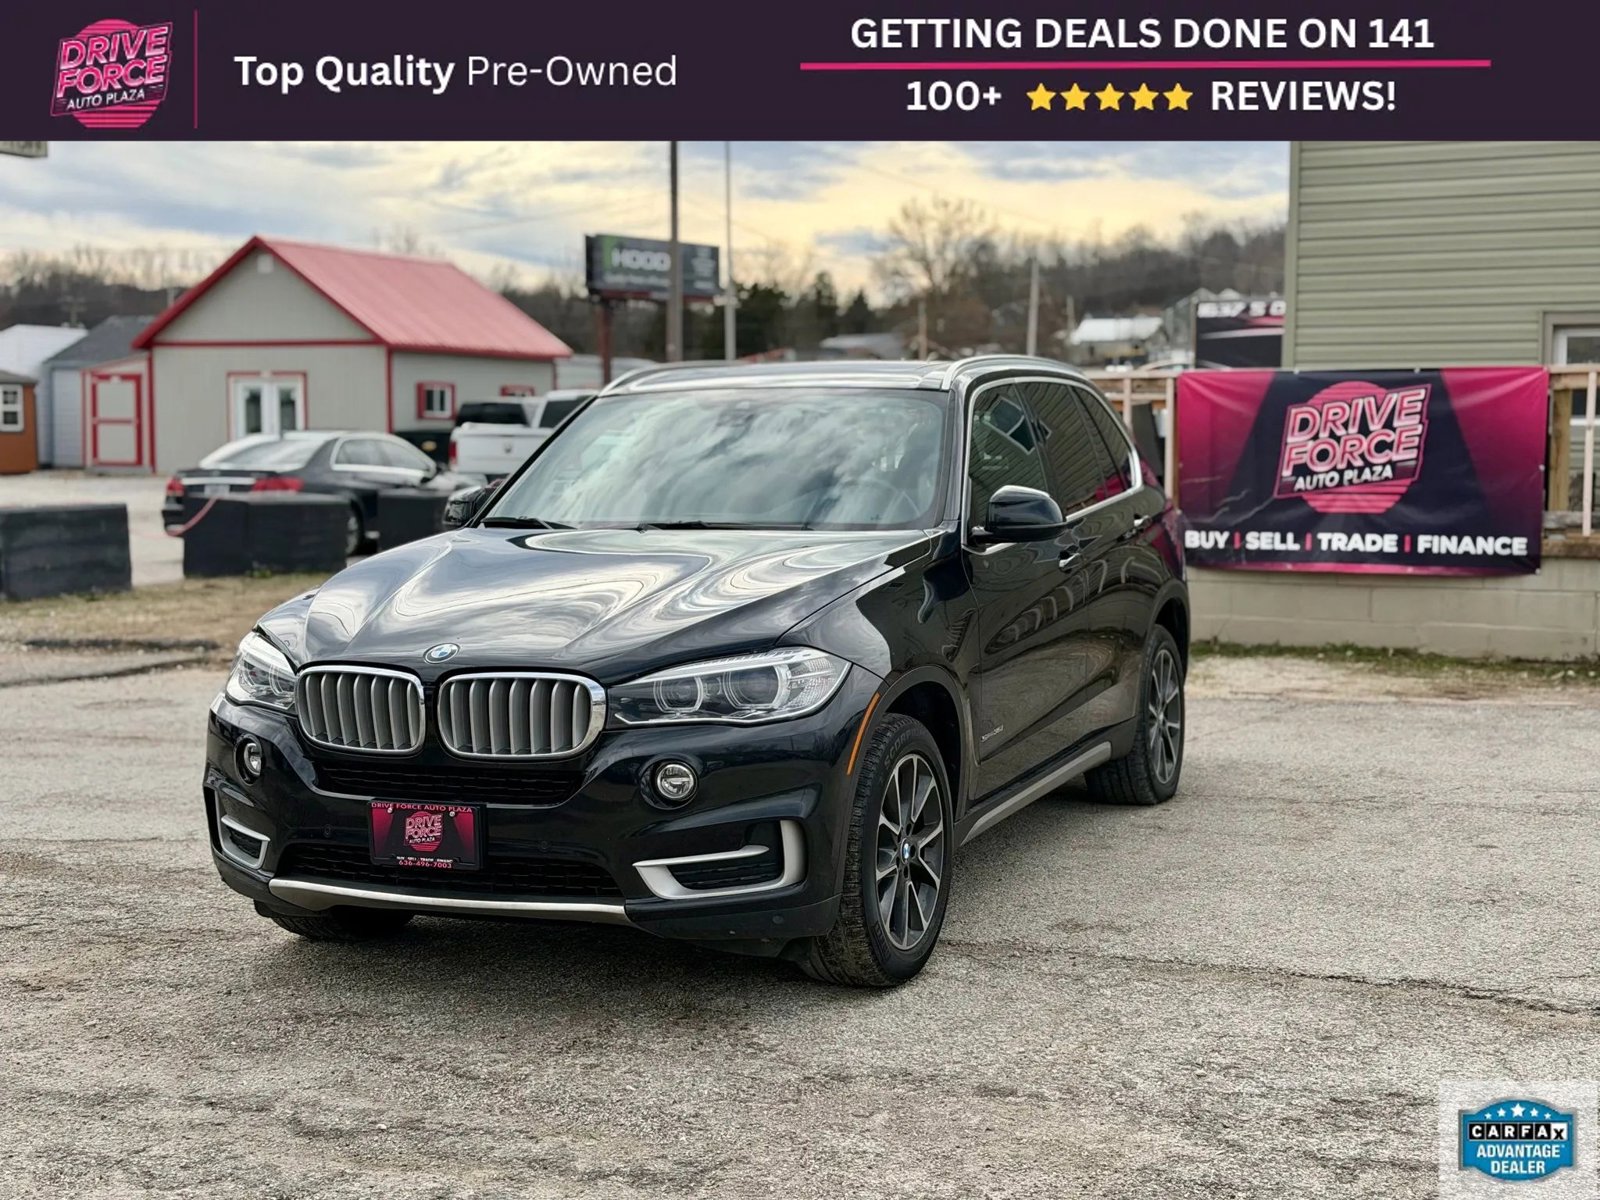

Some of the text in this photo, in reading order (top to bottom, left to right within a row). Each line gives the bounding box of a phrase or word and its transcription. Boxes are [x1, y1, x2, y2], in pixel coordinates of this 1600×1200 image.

[1287, 389, 1426, 443] DRIVE
[1282, 424, 1423, 477] FORCE
[1294, 465, 1393, 491] AUTO PLAZA
[1184, 529, 1528, 556] BUY SELL TRADE FINANCE
[405, 814, 442, 828] DRIVE
[405, 825, 442, 839] FORCE
